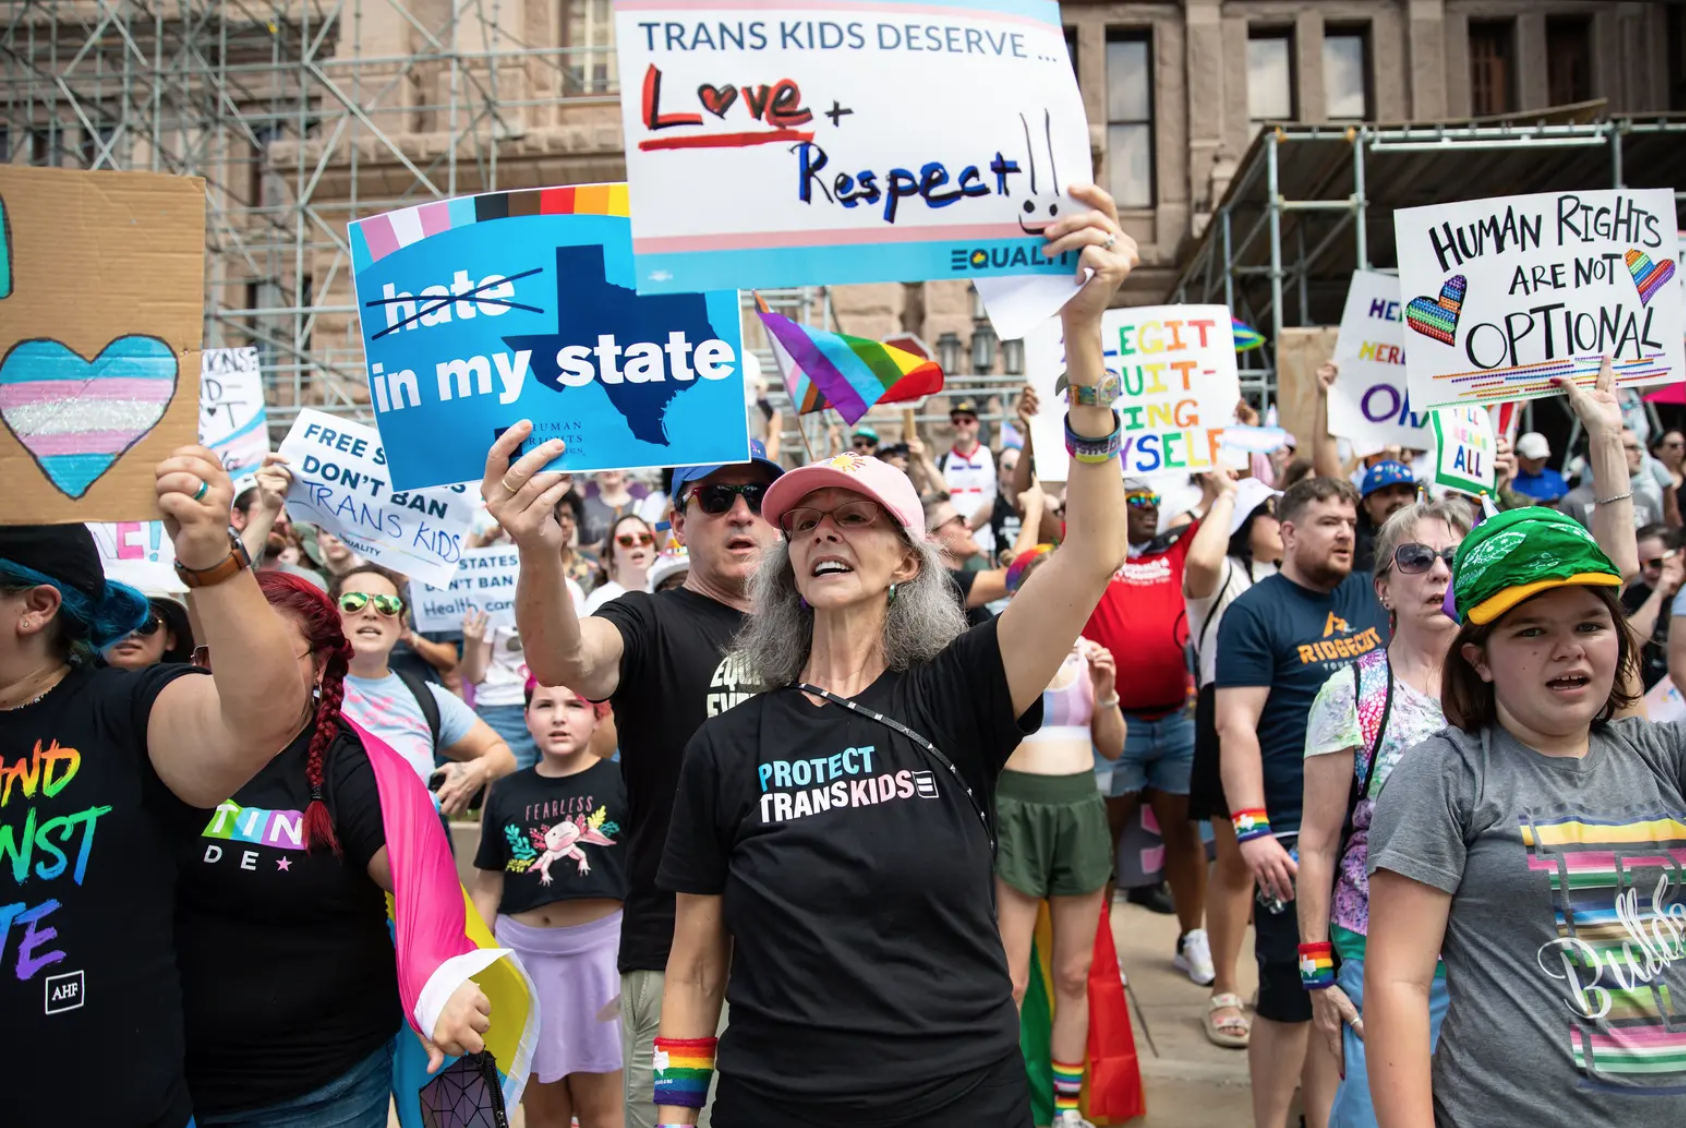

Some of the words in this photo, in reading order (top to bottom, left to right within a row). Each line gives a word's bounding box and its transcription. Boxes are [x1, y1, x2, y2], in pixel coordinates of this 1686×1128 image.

[638, 21, 768, 51] TRANS
[780, 22, 866, 51] KIDS
[877, 23, 1028, 59] DESERVE
[1428, 205, 1542, 273] HUMAN
[1557, 194, 1663, 248] RIGHTS
[1508, 263, 1566, 296] ARE
[1574, 253, 1623, 289] NOT
[382, 270, 516, 335] hate
[1368, 297, 1403, 323] HE
[1465, 302, 1663, 370] OPTIONAL
[372, 362, 422, 414] in
[435, 348, 533, 405] my
[555, 330, 736, 388] state
[1115, 399, 1200, 431] ING
[303, 422, 369, 459] FREE
[1119, 428, 1225, 473] YSELF
[1453, 444, 1483, 478] ALL
[302, 454, 386, 497] DON'T
[390, 491, 449, 520] BAN
[302, 479, 404, 539] TRANS
[412, 520, 462, 564] KIDS
[458, 554, 519, 571] STATES
[424, 577, 473, 592] DN'T
[478, 575, 514, 589] BAN
[423, 596, 479, 617] Health
[485, 600, 515, 613] car
[1296, 626, 1383, 665] RIDGECUT
[758, 745, 876, 793] PROTECT
[525, 795, 594, 822] FEARLESS
[760, 780, 849, 824] TRANS
[850, 769, 916, 809] KIDS
[52, 982, 79, 1002] AHF
